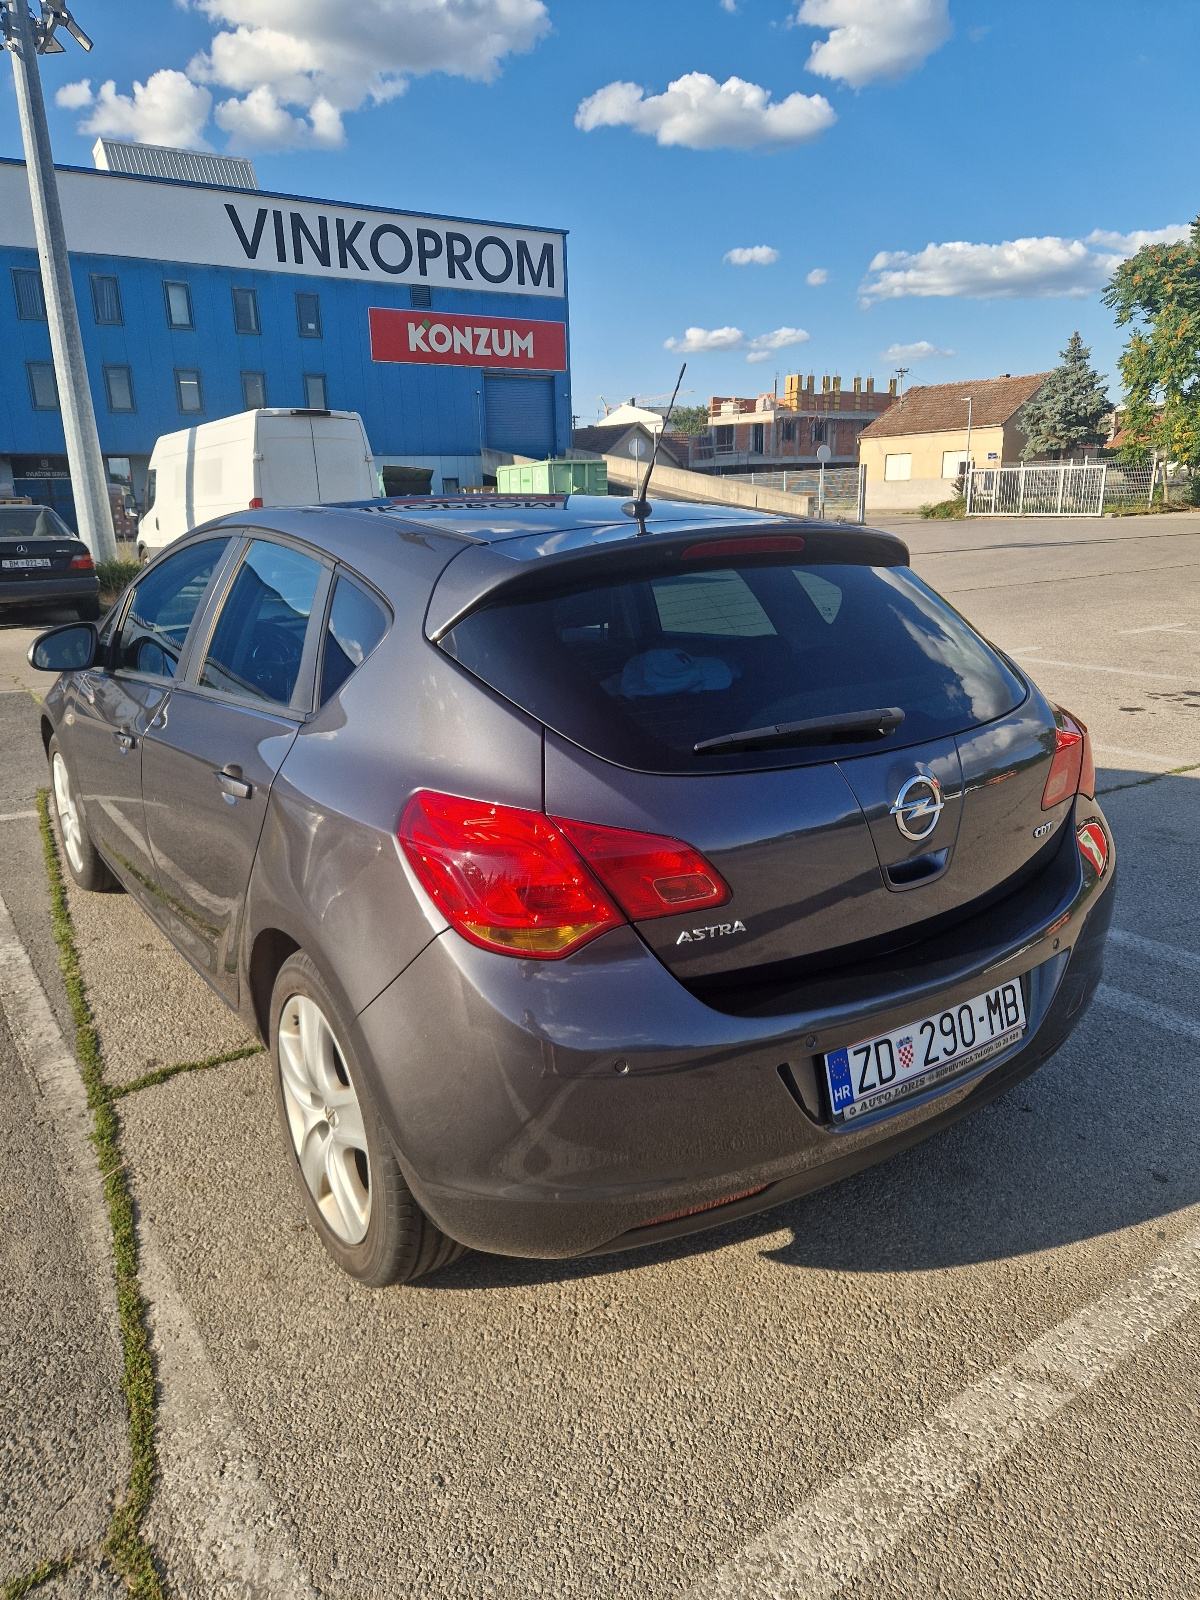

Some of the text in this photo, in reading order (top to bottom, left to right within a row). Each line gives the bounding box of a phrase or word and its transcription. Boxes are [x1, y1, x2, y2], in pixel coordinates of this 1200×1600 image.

[224, 203, 555, 288] VINKOPROM
[407, 321, 534, 358] KONZUM
[676, 920, 747, 945] ASTRA
[853, 984, 1020, 1095] ZD 290-MB
[834, 1084, 852, 1102] HR
[860, 1091, 891, 1111] AUTO
[894, 1077, 925, 1097] LORIS
